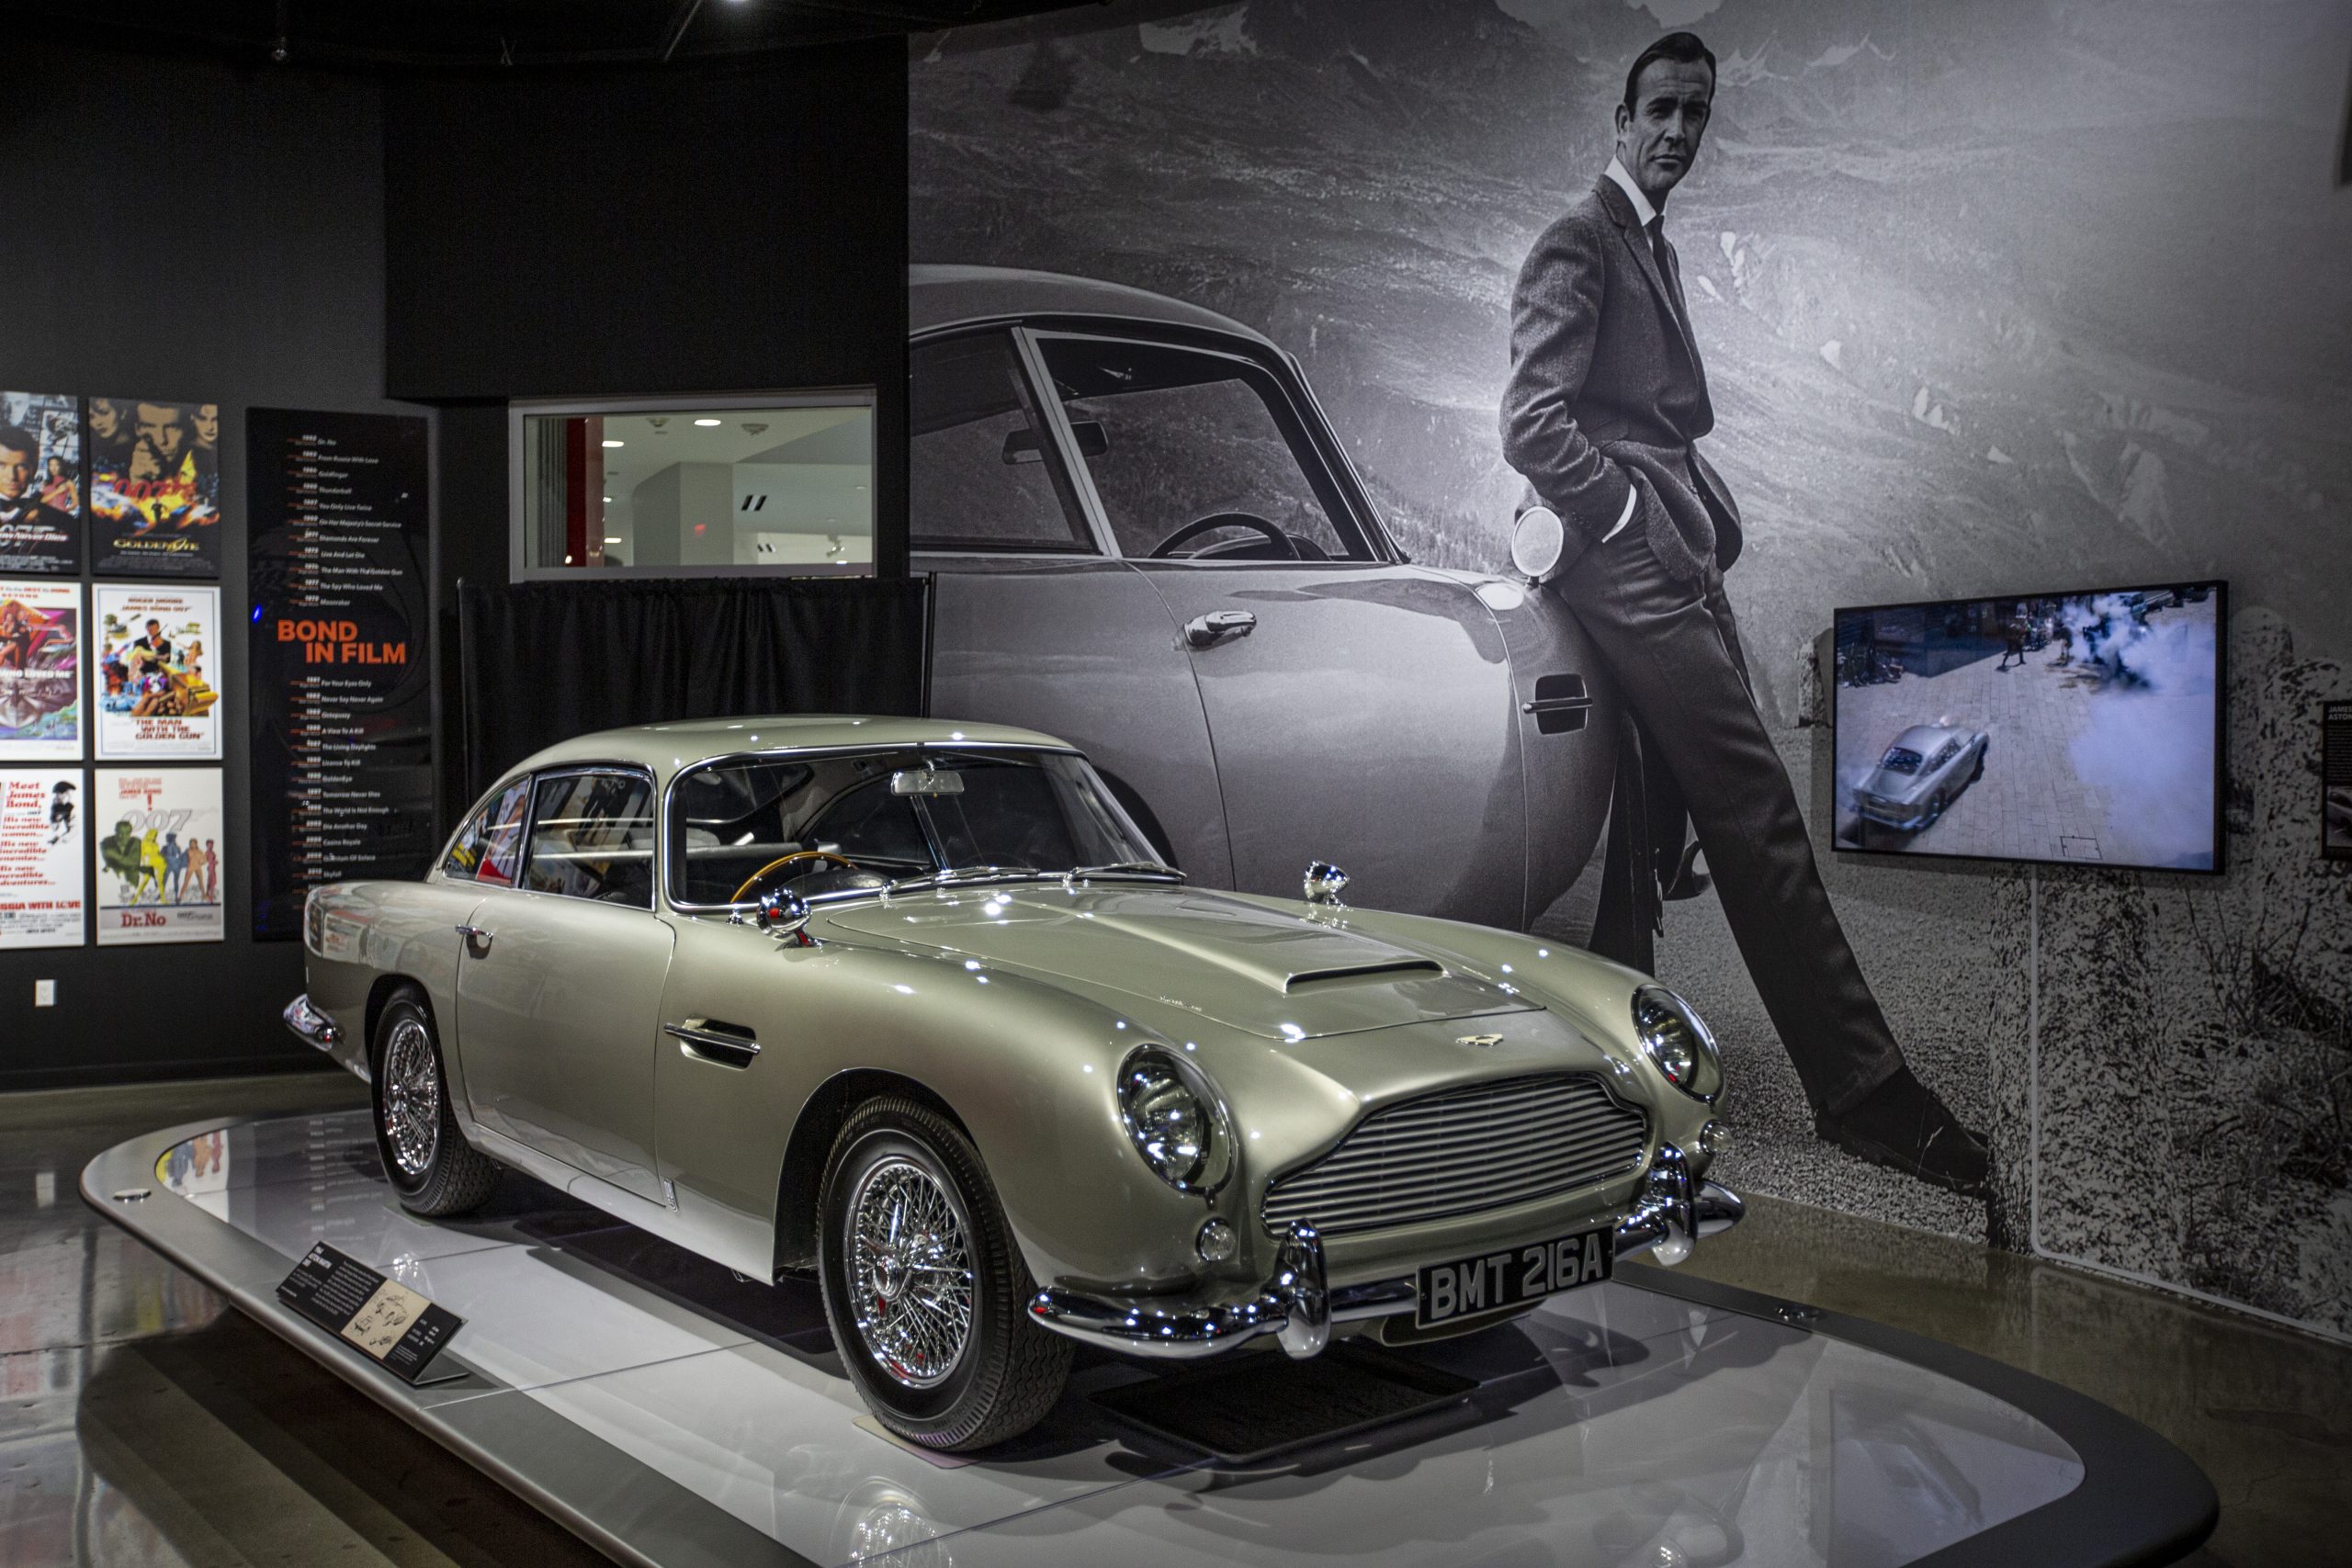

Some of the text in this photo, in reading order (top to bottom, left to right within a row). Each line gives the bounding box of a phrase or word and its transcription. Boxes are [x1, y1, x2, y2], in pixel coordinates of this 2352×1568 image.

[277, 620, 358, 642] BOND
[306, 642, 406, 664] IN FILM
[120, 810, 192, 831] 007
[1431, 1233, 1603, 1320] BMT 216A
